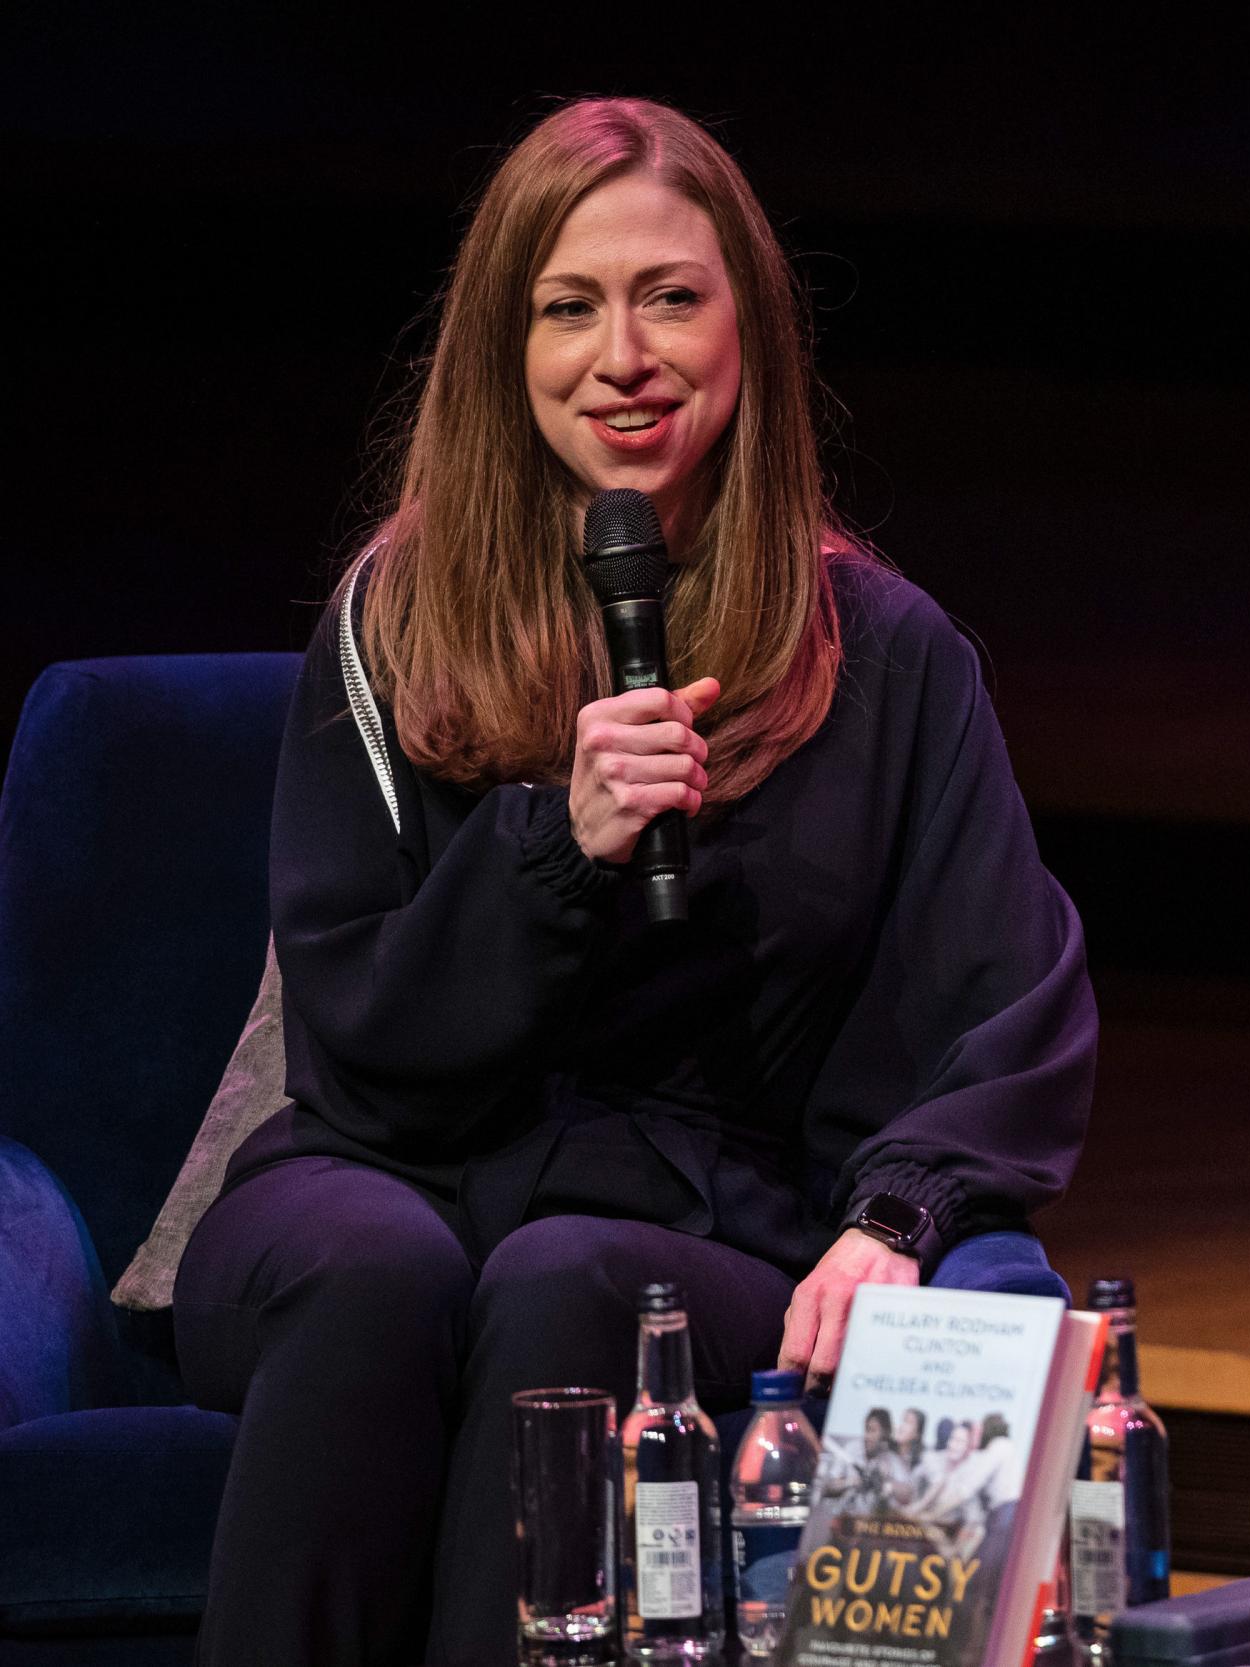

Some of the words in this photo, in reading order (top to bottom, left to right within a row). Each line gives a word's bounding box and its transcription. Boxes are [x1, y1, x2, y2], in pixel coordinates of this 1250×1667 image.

[872, 1312, 940, 1329] HILLARY
[946, 1315, 1024, 1336] RODHAM
[903, 1335, 982, 1356] CLINTON
[921, 1361, 955, 1374] AND
[852, 1374, 929, 1393] CHELSEA
[934, 1380, 1015, 1401] CLINTON
[807, 1545, 981, 1602] GUTSY
[811, 1597, 953, 1638] WOMEN
